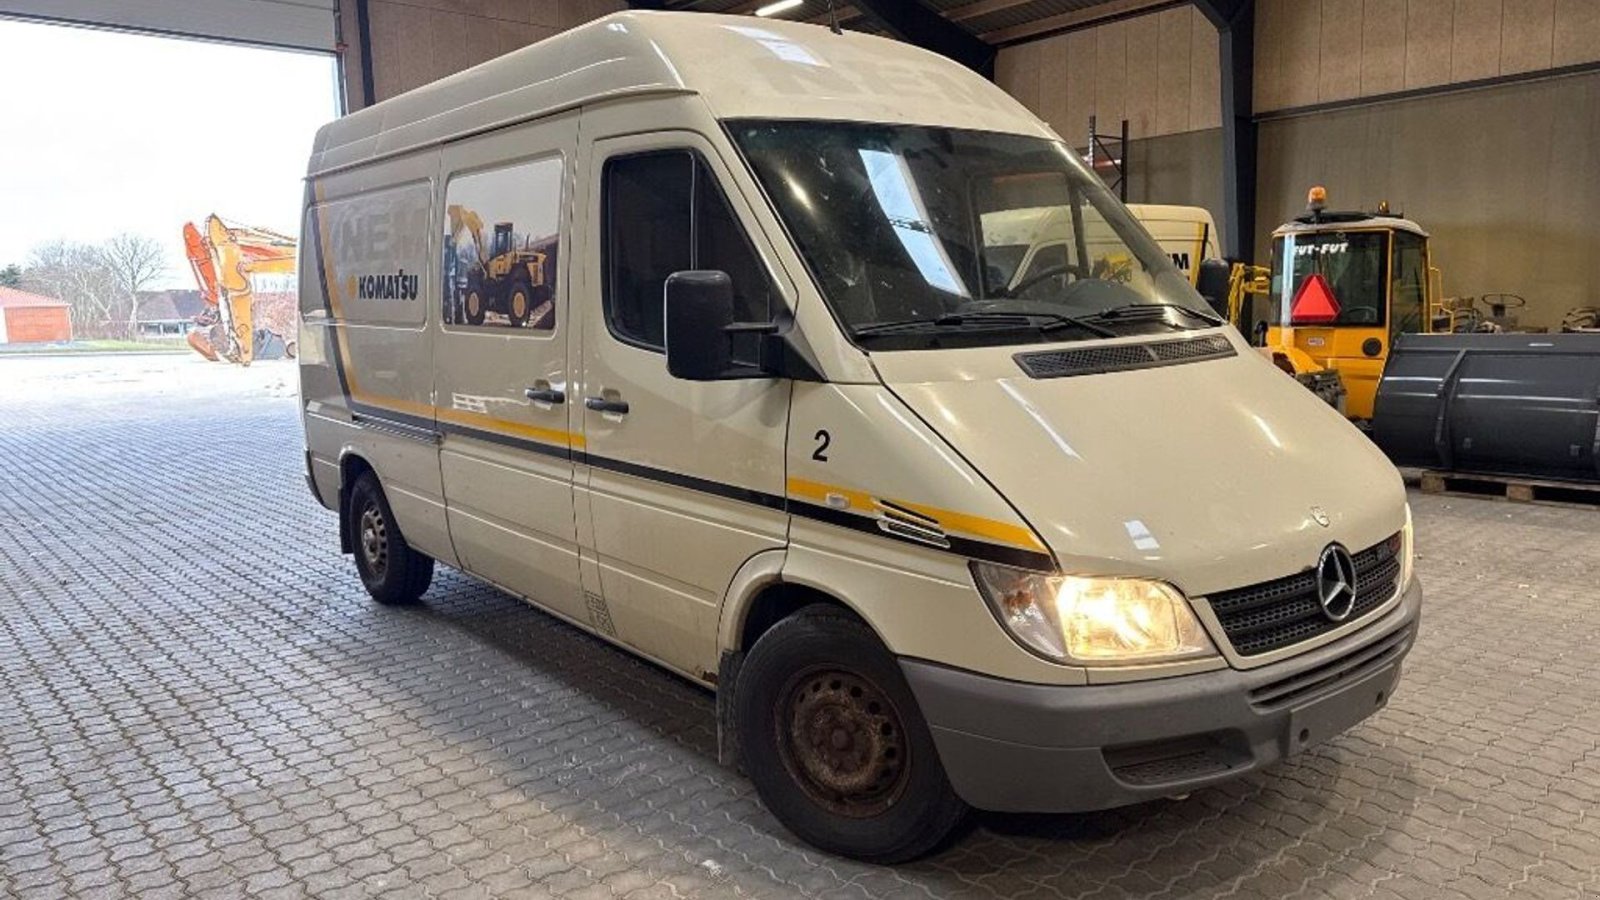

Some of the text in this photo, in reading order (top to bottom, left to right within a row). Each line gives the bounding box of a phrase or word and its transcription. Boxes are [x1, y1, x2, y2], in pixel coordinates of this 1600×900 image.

[1166, 252, 1190, 270] M
[358, 268, 418, 301] KOMATSU
[812, 429, 831, 462] 2
